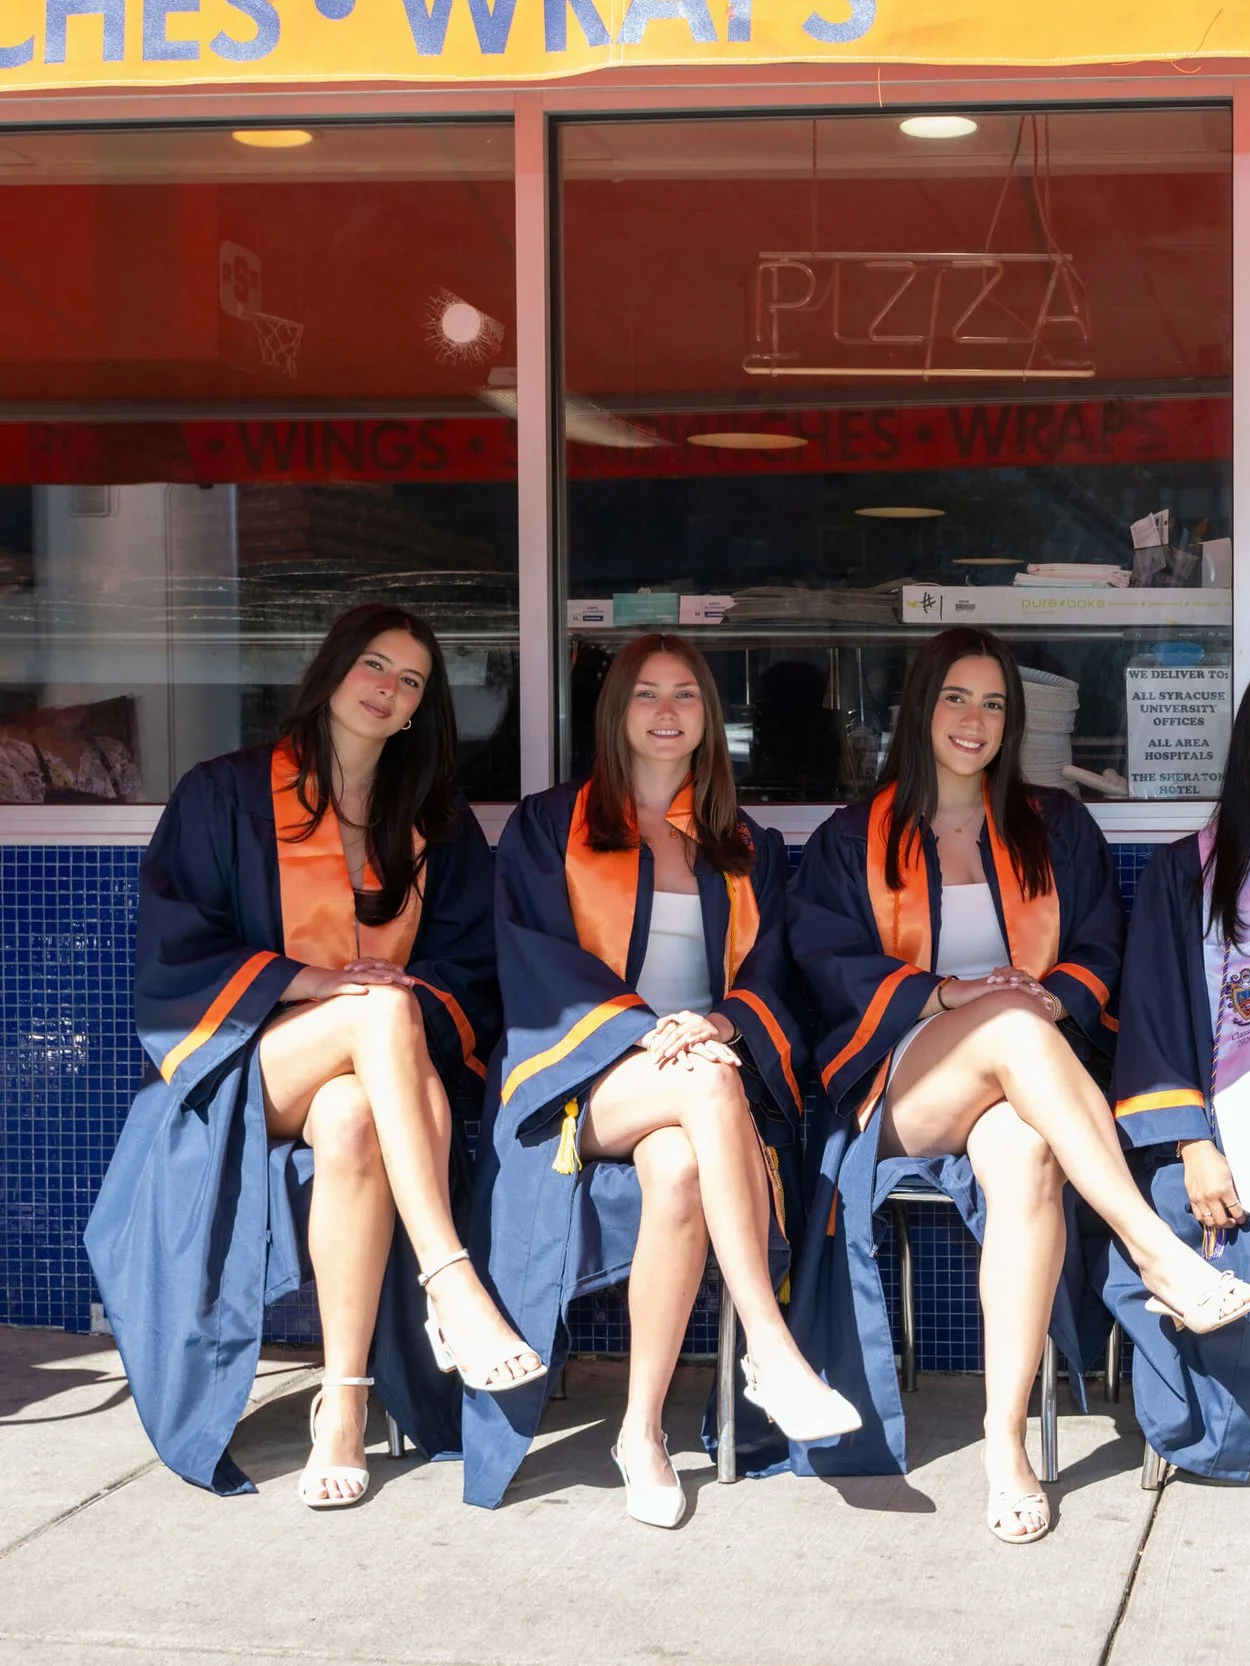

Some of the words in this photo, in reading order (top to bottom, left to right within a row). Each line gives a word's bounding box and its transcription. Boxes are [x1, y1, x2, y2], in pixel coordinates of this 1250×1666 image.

[753, 261, 1090, 343] PIZZA
[236, 417, 449, 472] WINGS
[947, 402, 1168, 459] WRAPS
[1129, 670, 1148, 679] WE
[1151, 670, 1205, 679] DELIVER
[1208, 670, 1229, 679] TO:
[1132, 691, 1156, 700] ALL
[1158, 691, 1225, 700] SYRACUSE
[1140, 704, 1218, 713] UNIVERSITY
[1152, 717, 1205, 726] OFFICES
[1148, 739, 1172, 748] ALL
[1175, 739, 1210, 748] AREA
[1145, 751, 1214, 761] HOSPITALS
[1131, 773, 1156, 782] THE
[1159, 785, 1200, 795] HOTEL
[1231, 1030, 1250, 1041] Class
